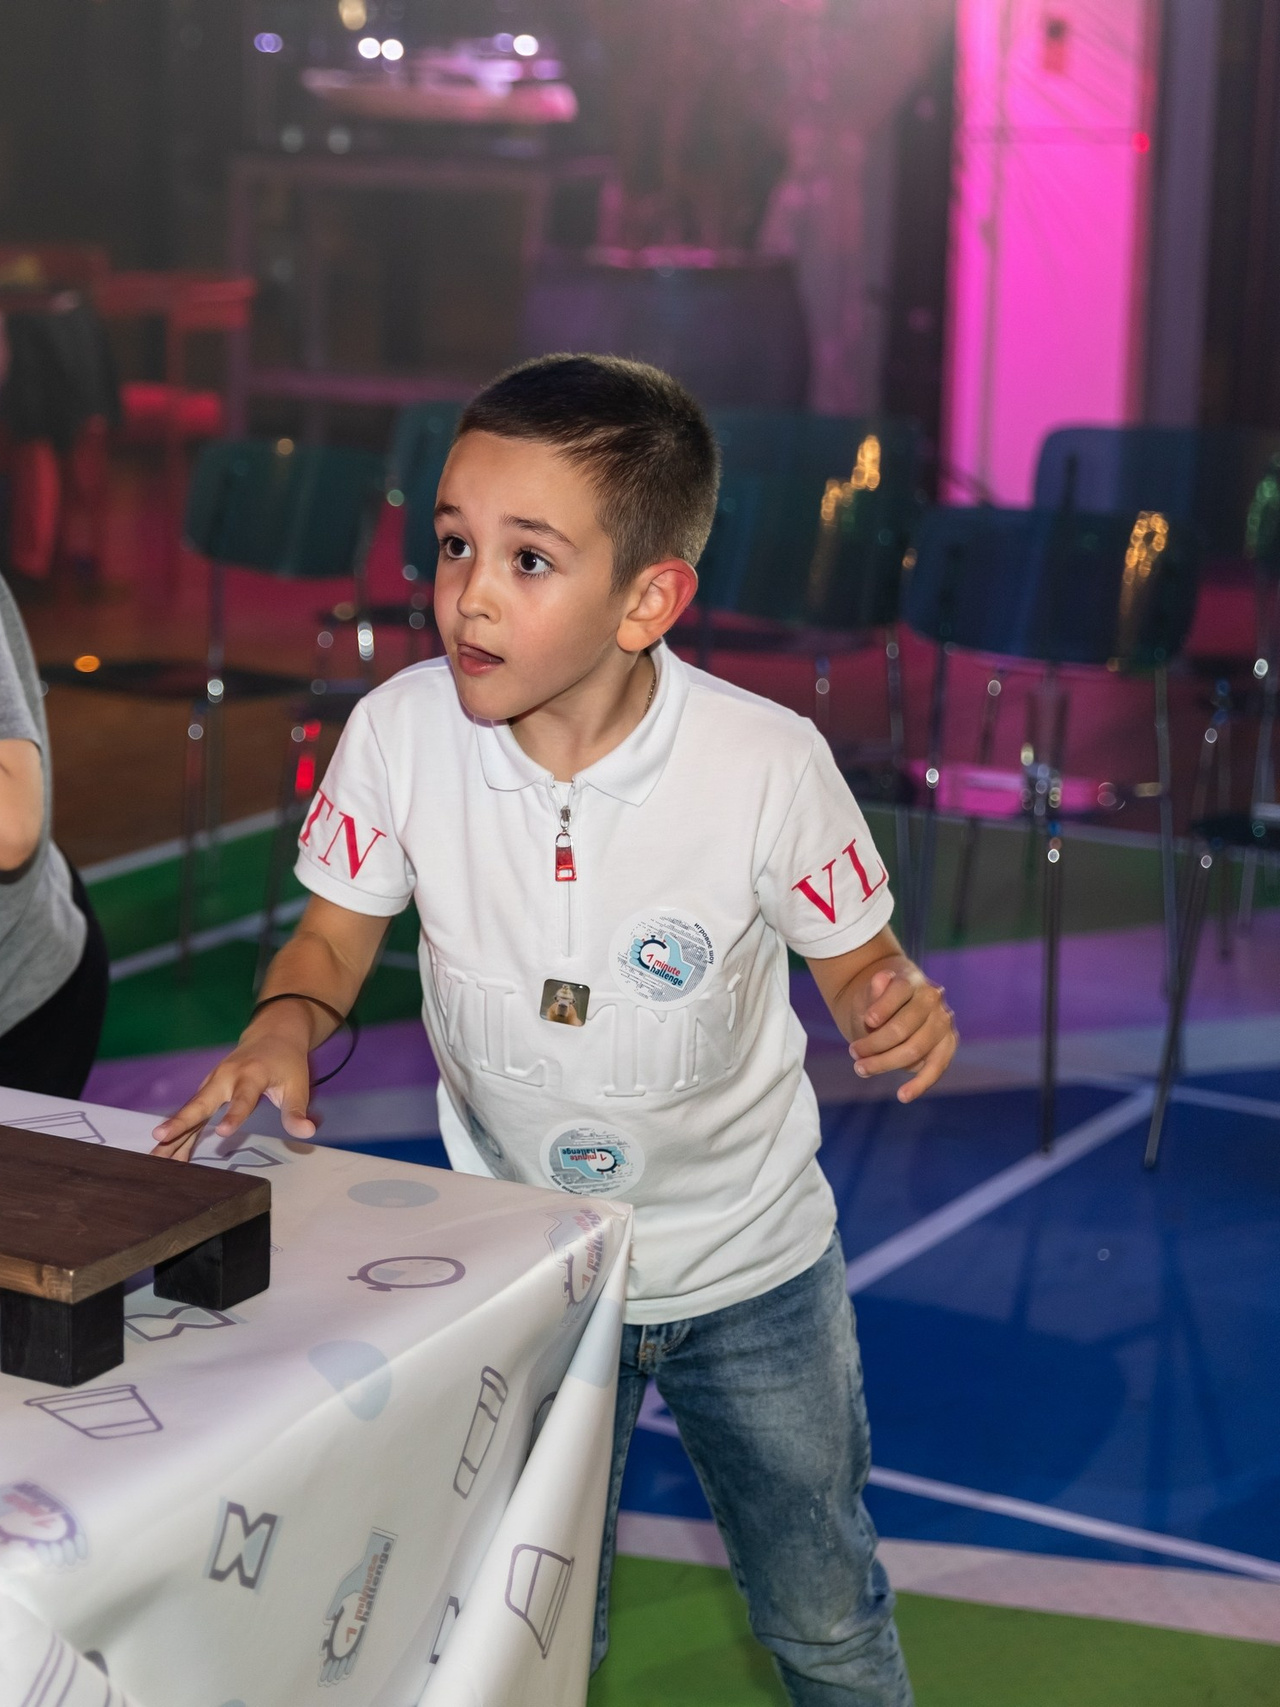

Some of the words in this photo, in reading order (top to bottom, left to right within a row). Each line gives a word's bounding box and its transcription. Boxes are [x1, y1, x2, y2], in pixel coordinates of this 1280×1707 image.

[791, 838, 887, 924] VL
[694, 922, 713, 949] игровое
[654, 959, 681, 976] minute
[569, 1153, 597, 1161] minute
